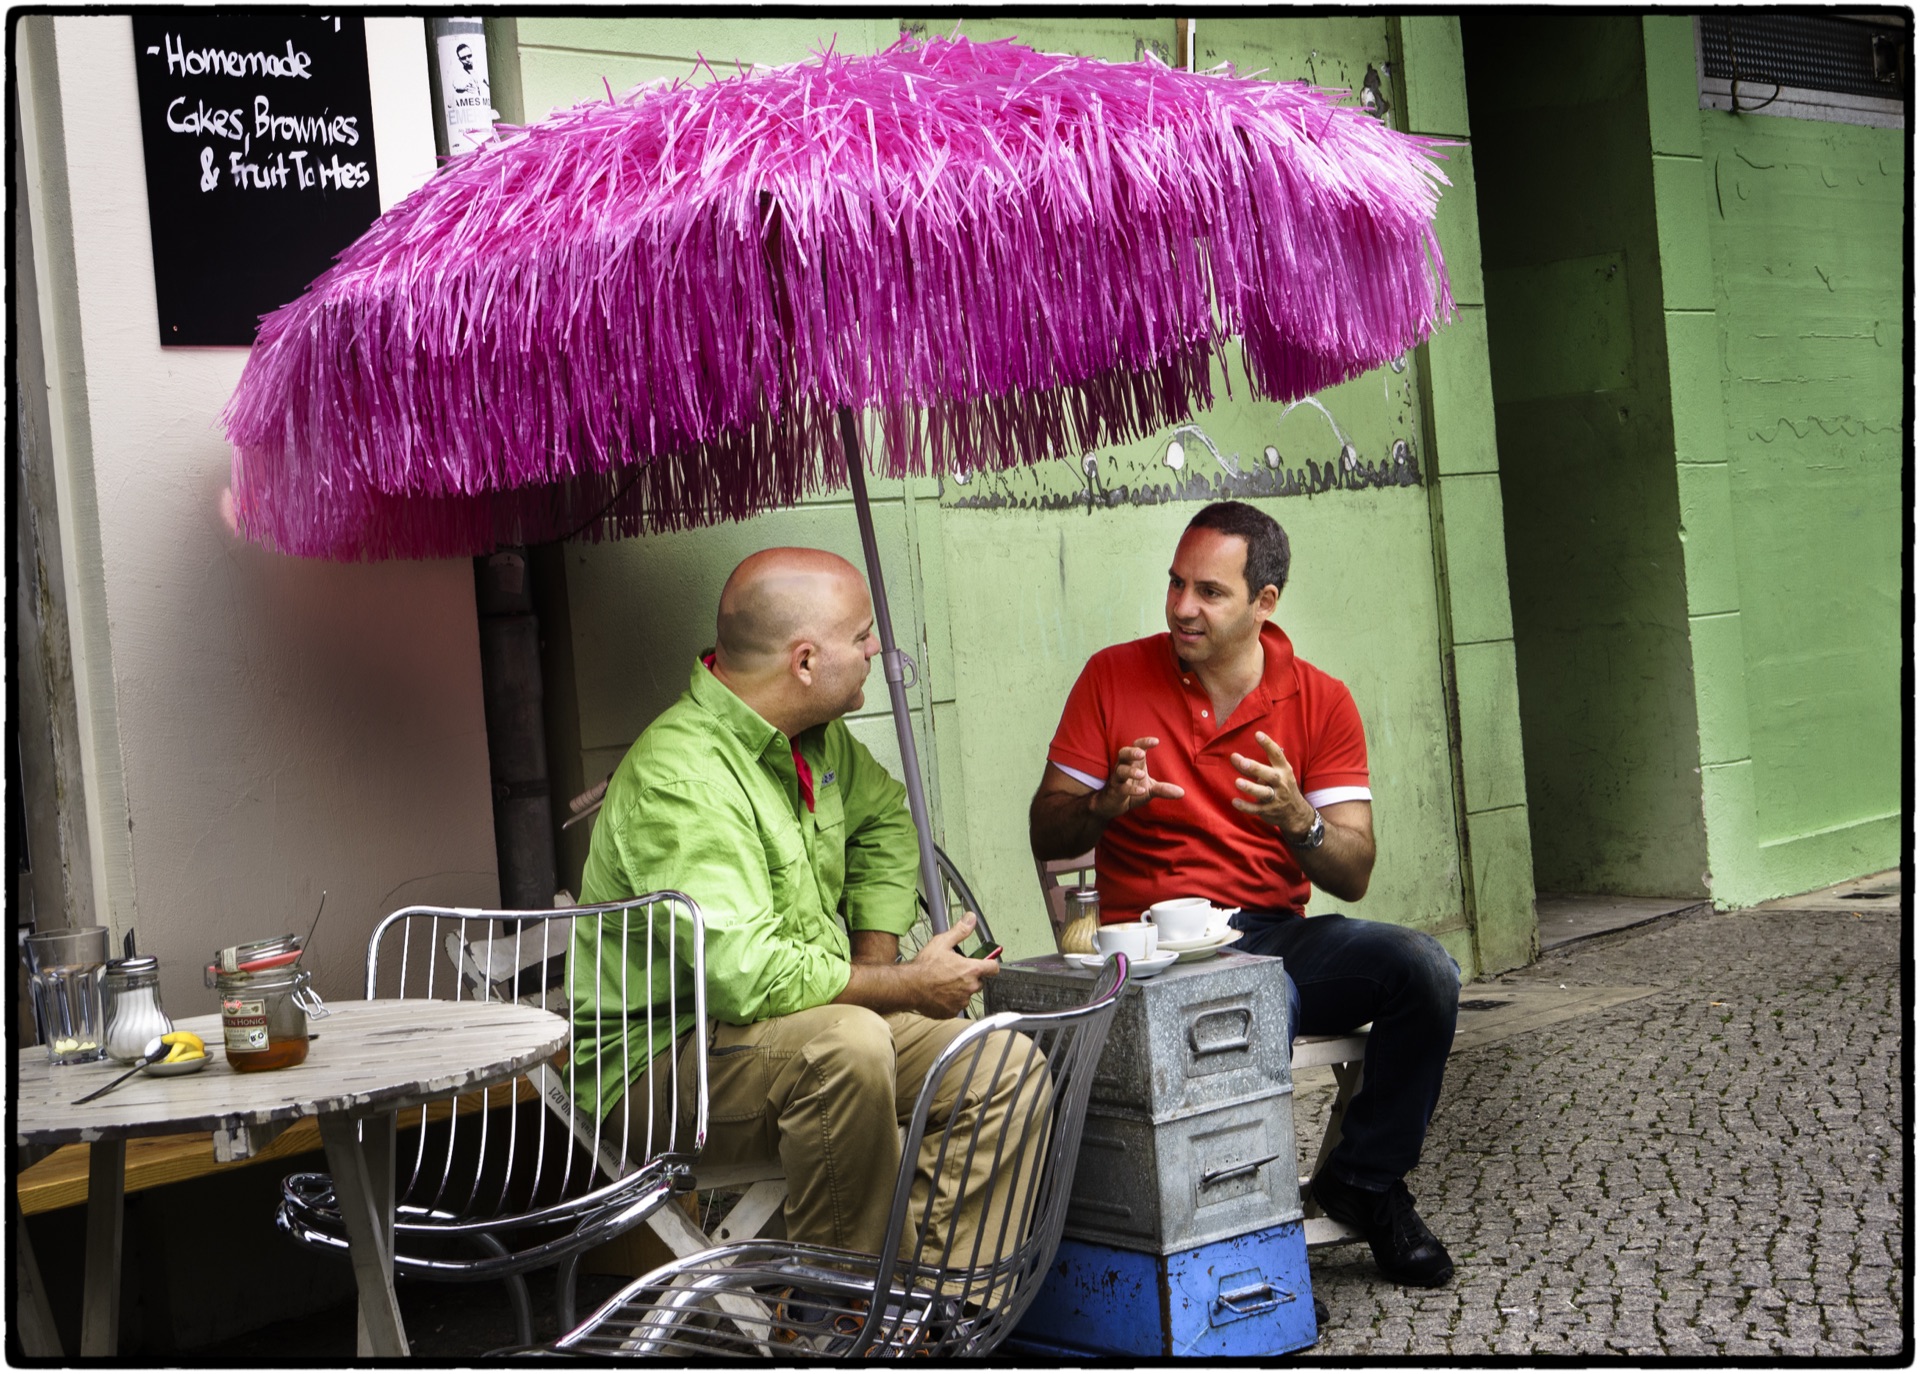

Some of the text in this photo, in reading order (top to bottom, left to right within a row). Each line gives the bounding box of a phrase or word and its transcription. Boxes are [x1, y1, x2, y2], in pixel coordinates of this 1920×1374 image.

[254, 94, 360, 147] Brownies
[200, 146, 221, 193] &
[229, 151, 291, 190] Fruit
[236, 1017, 265, 1027] HONIG
[548, 1086, 565, 1105] 021
